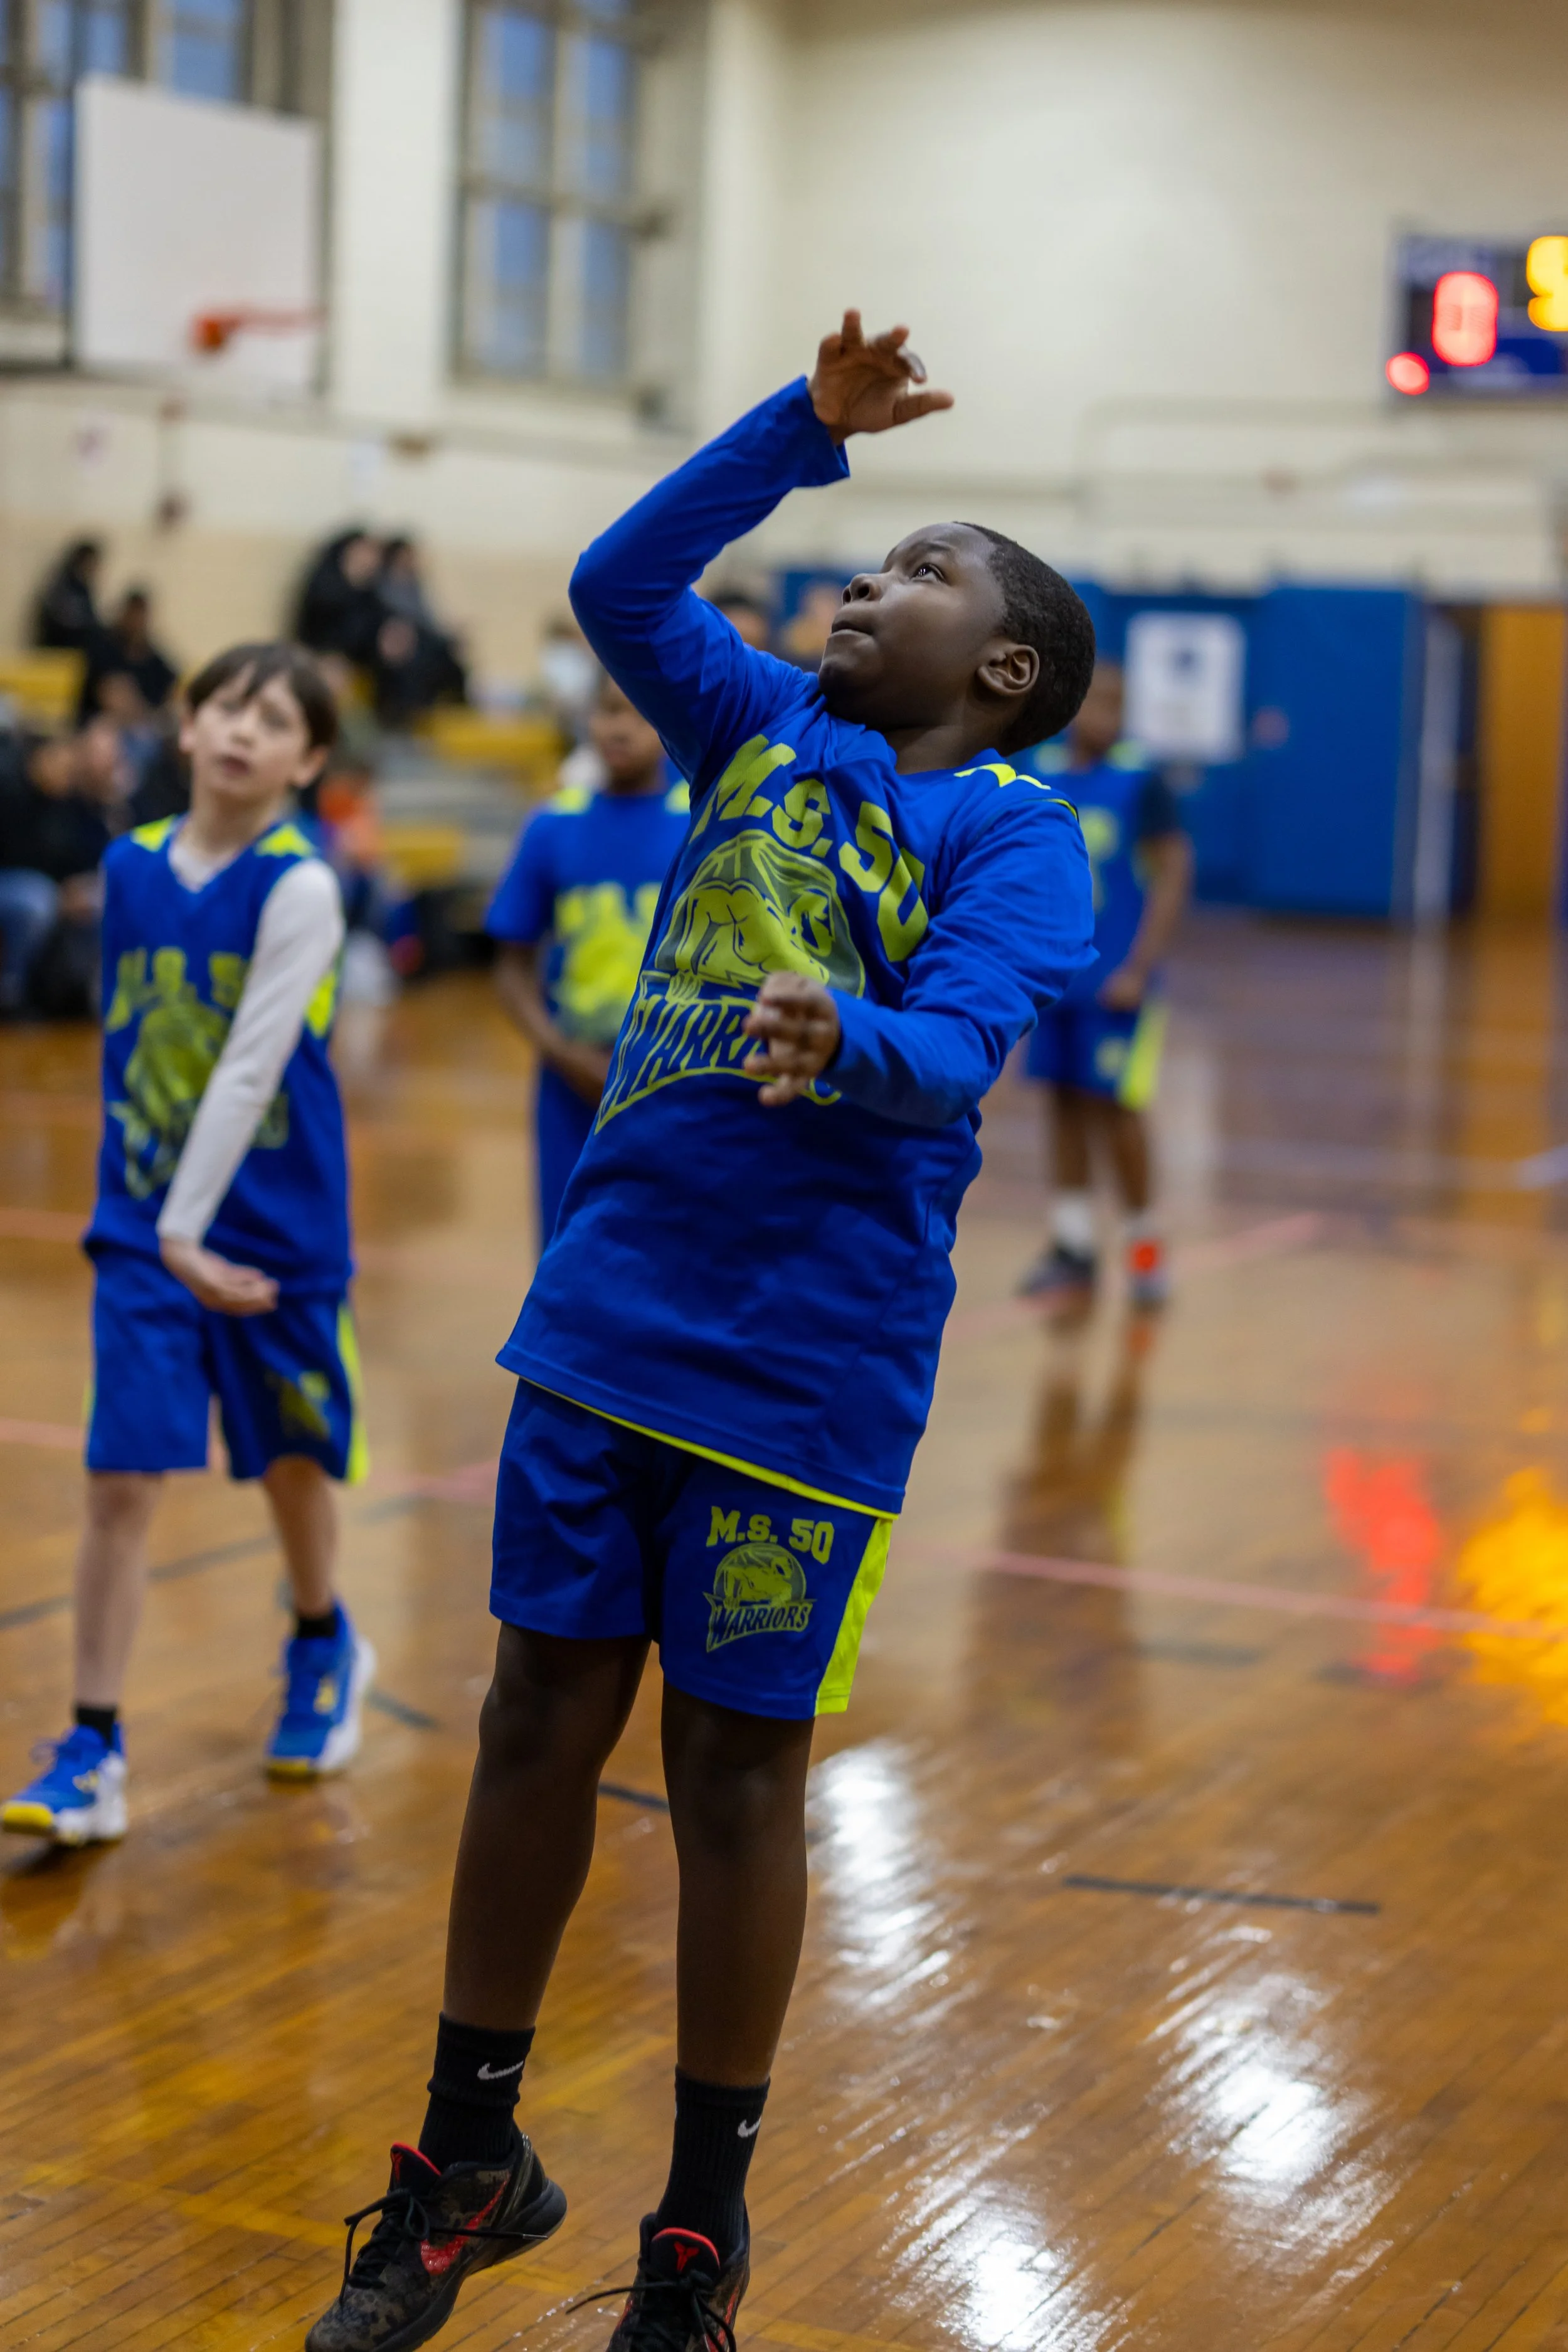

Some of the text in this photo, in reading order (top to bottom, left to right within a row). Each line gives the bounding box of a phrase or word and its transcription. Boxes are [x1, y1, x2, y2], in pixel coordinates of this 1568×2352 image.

[689, 734, 833, 858] M.S.
[706, 1506, 835, 1564] M.S. 50
[706, 1602, 813, 1653] WARRIORS
